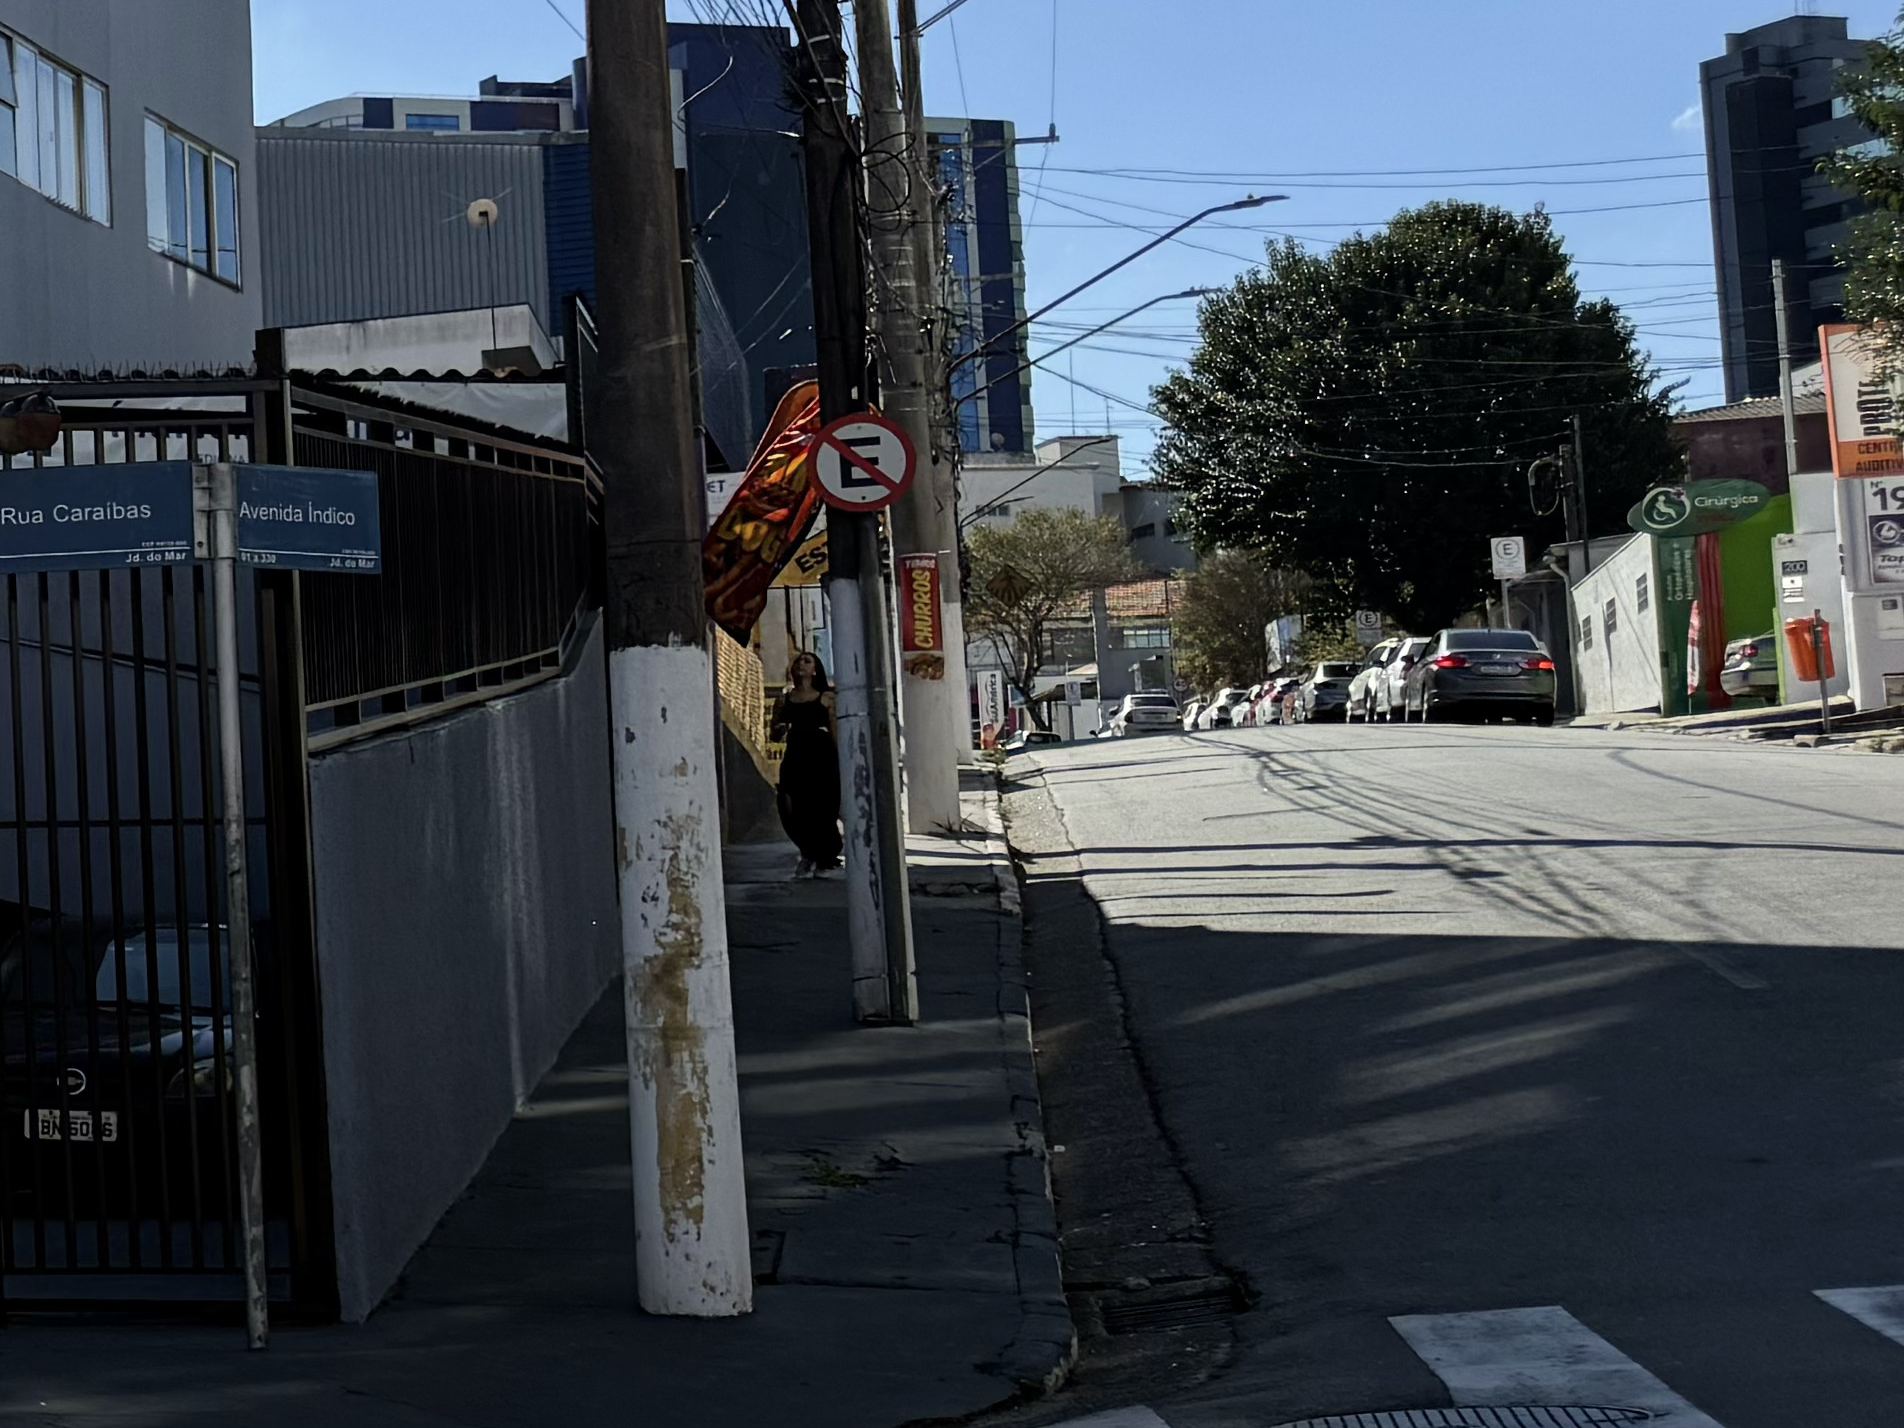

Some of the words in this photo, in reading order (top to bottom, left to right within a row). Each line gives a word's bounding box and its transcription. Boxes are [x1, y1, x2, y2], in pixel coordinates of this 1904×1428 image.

[839, 436, 881, 489] E
[0, 507, 44, 525] Rua
[52, 502, 152, 523] Caraíbas
[239, 501, 303, 522] Avenida
[308, 501, 356, 526] Índico
[1694, 494, 1759, 509] Cirúrgica
[146, 551, 162, 562] do
[164, 551, 186, 561] Mar
[911, 569, 934, 649] CHURROS
